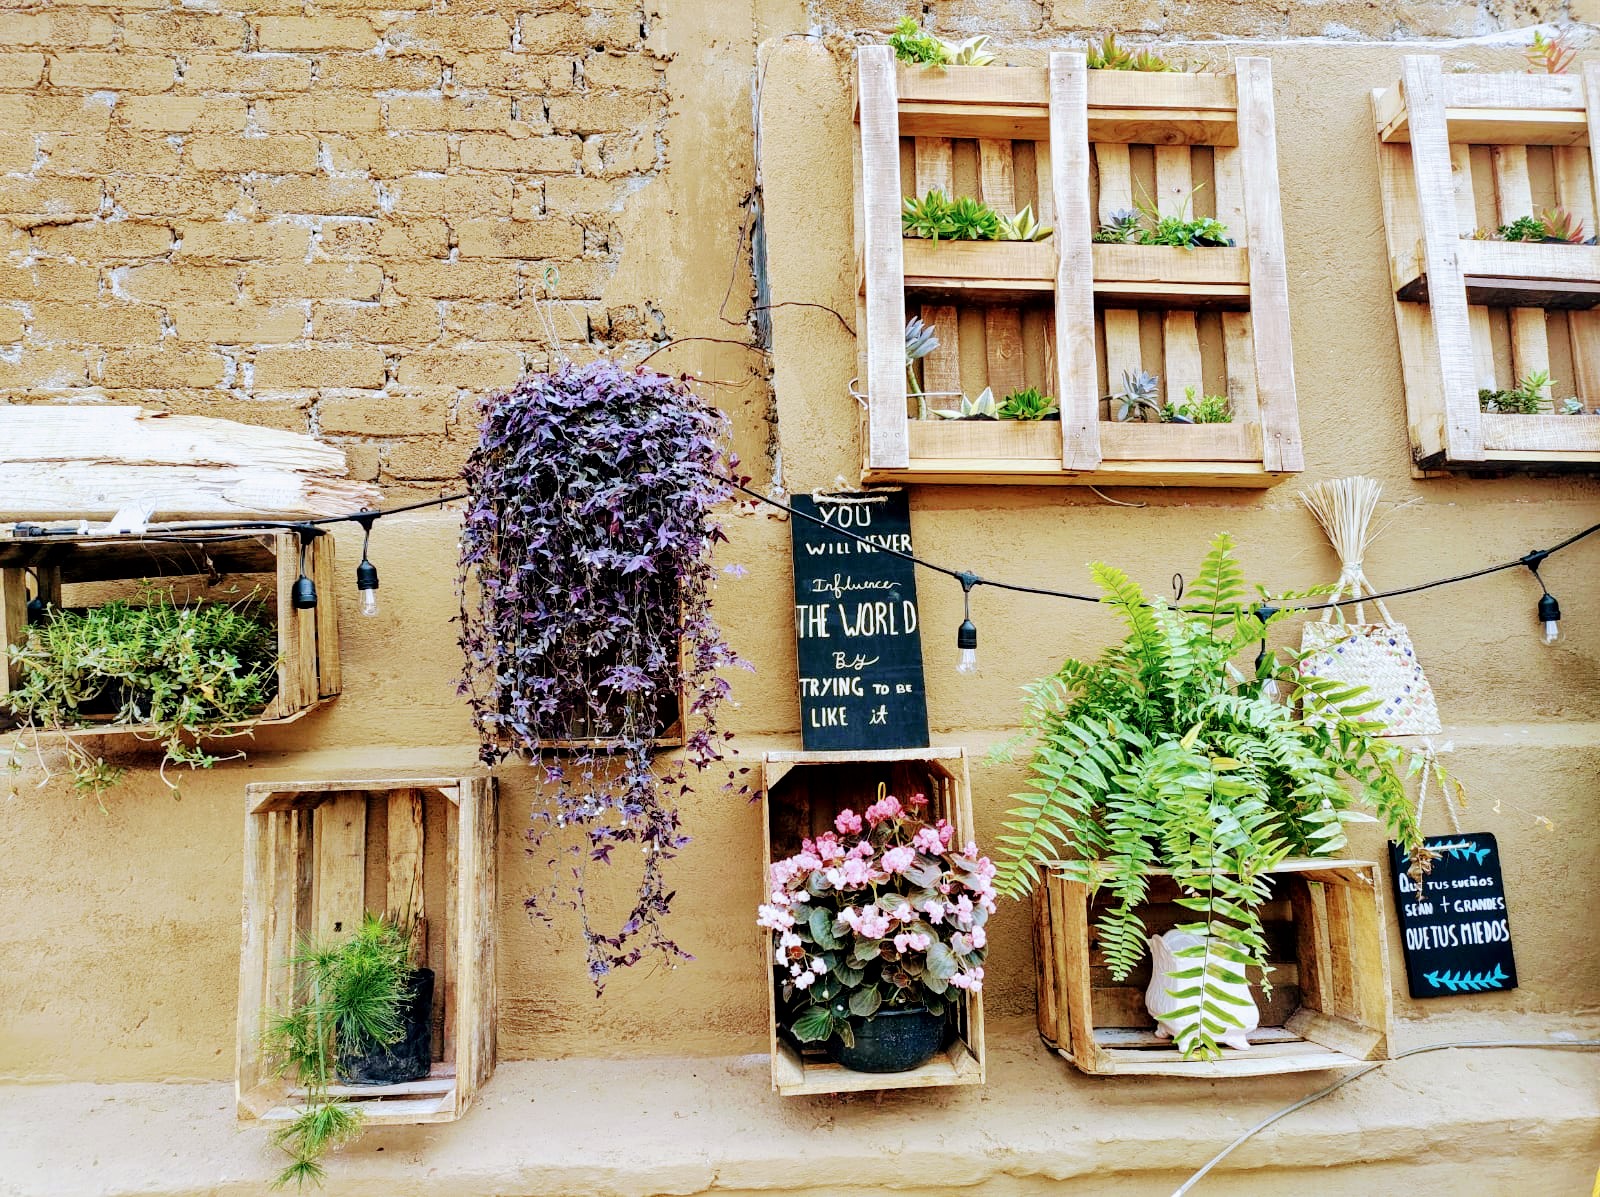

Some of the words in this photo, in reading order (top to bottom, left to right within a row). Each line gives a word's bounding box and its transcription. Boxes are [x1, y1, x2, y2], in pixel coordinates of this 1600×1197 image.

[819, 505, 871, 528] YOU
[805, 542, 851, 555] WILL
[856, 534, 913, 553] NEVER
[811, 573, 902, 599] Influence
[796, 604, 830, 638] THE
[838, 600, 917, 637] WORLD
[832, 651, 880, 670] By
[799, 677, 864, 697] TRYING
[872, 683, 890, 695] TO
[895, 684, 913, 694] BE
[811, 706, 849, 728] LIKE
[869, 704, 888, 725] it
[1427, 880, 1449, 891] TUS
[1451, 875, 1494, 889] SUEÑOS
[1404, 902, 1434, 917] SEAN
[1453, 896, 1505, 913] GRANDES
[1460, 918, 1510, 946] MIEDOS
